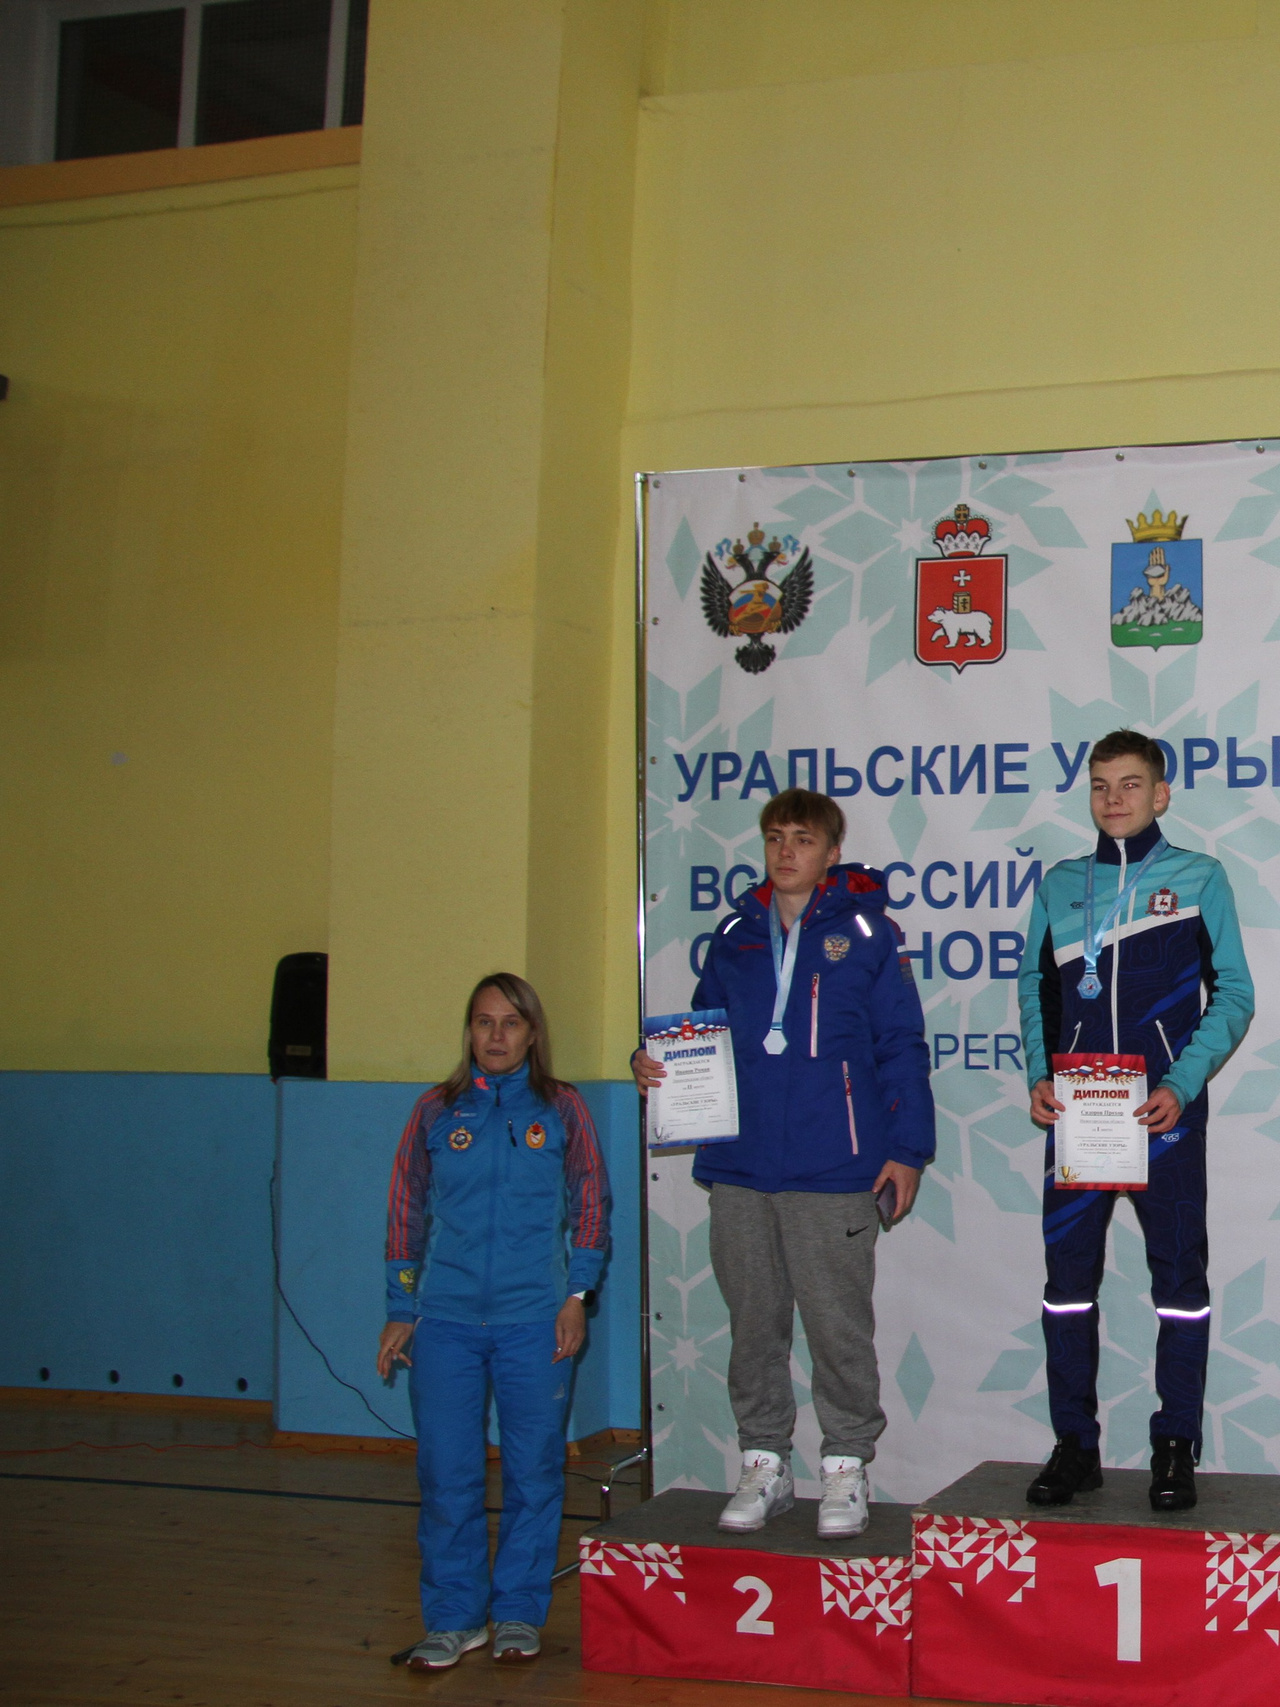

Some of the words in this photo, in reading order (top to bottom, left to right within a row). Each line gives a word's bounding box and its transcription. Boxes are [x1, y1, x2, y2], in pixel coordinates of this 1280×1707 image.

[673, 742, 1029, 803] УРАЛЬСКИЕ
[663, 1045, 717, 1062] ДИПЛОМ
[934, 1033, 1024, 1070] PER
[1073, 1089, 1129, 1100] ДИПЛОМ
[733, 1575, 775, 1636] 2
[1094, 1557, 1142, 1662] 1
